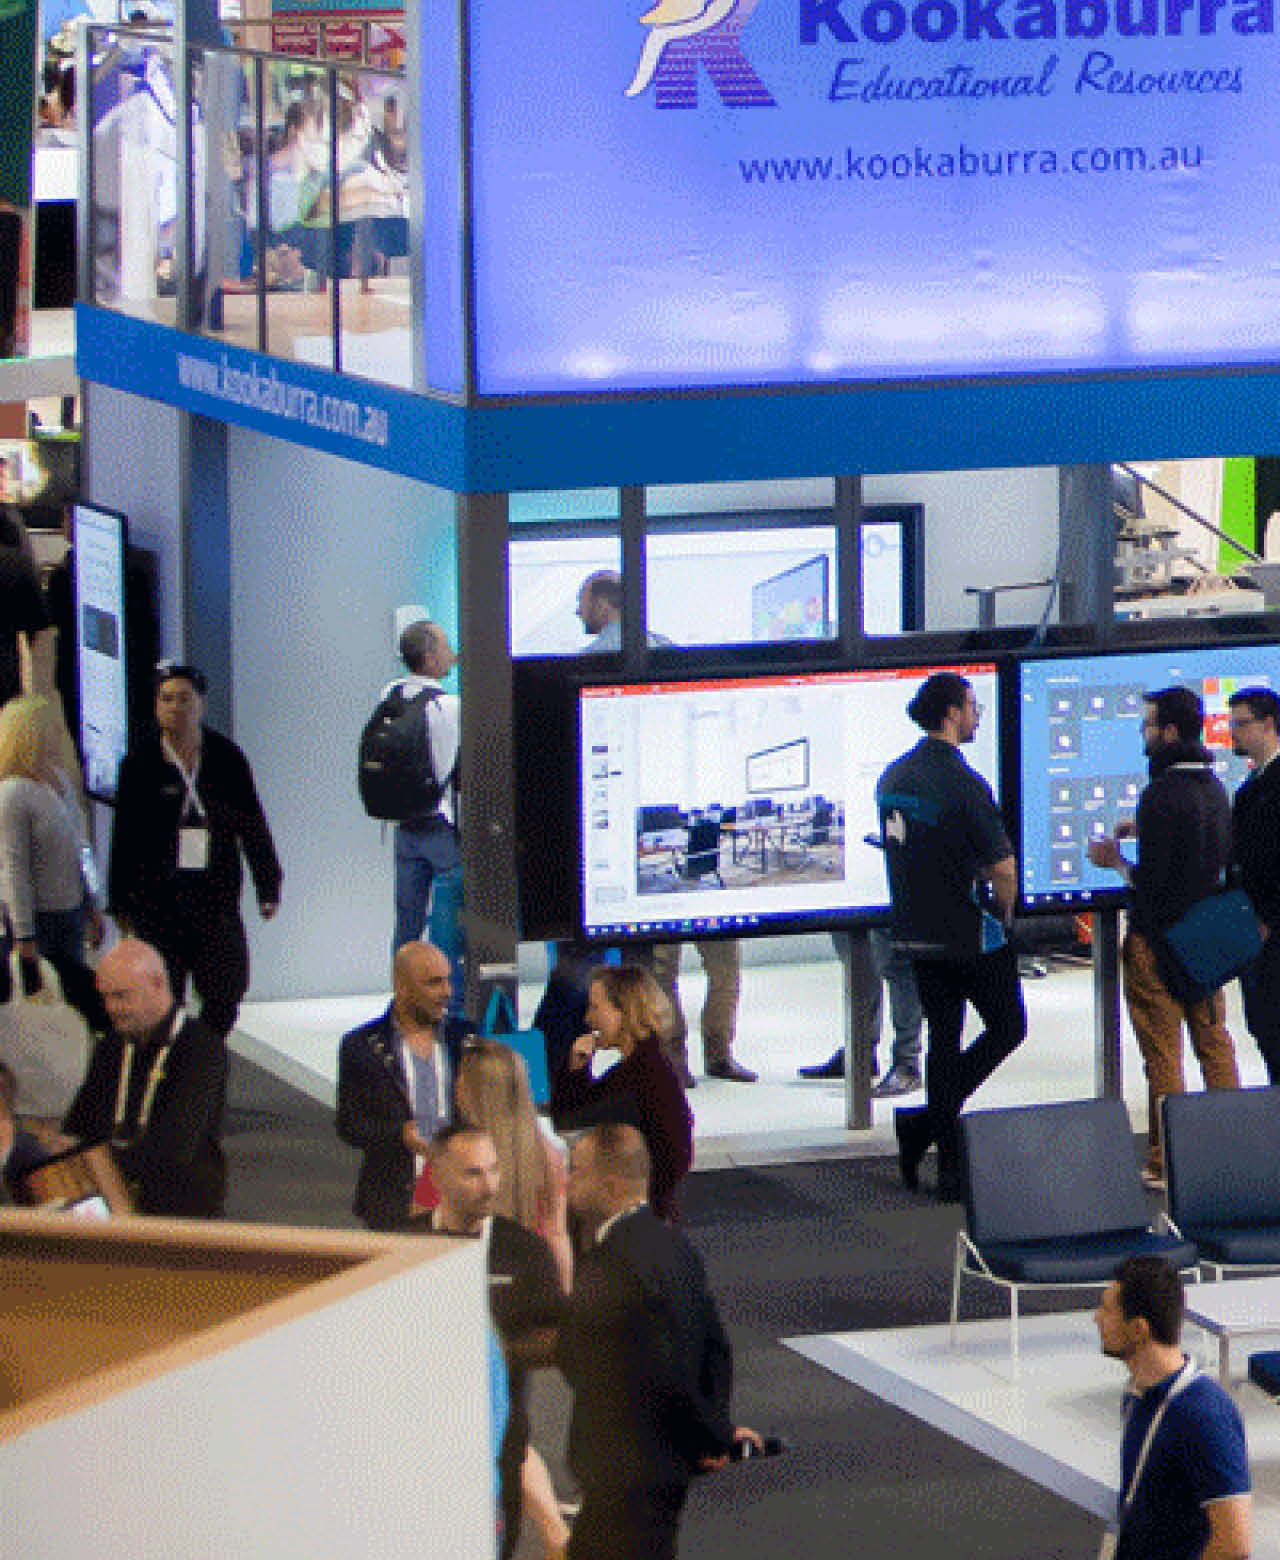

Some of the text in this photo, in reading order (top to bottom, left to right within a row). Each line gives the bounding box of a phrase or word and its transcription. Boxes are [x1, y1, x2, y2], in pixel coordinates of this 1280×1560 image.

[800, 0, 1274, 45] Kookaburra
[829, 51, 1244, 101] Educational Resources
[739, 144, 1202, 183] www.kookaburra.com.au
